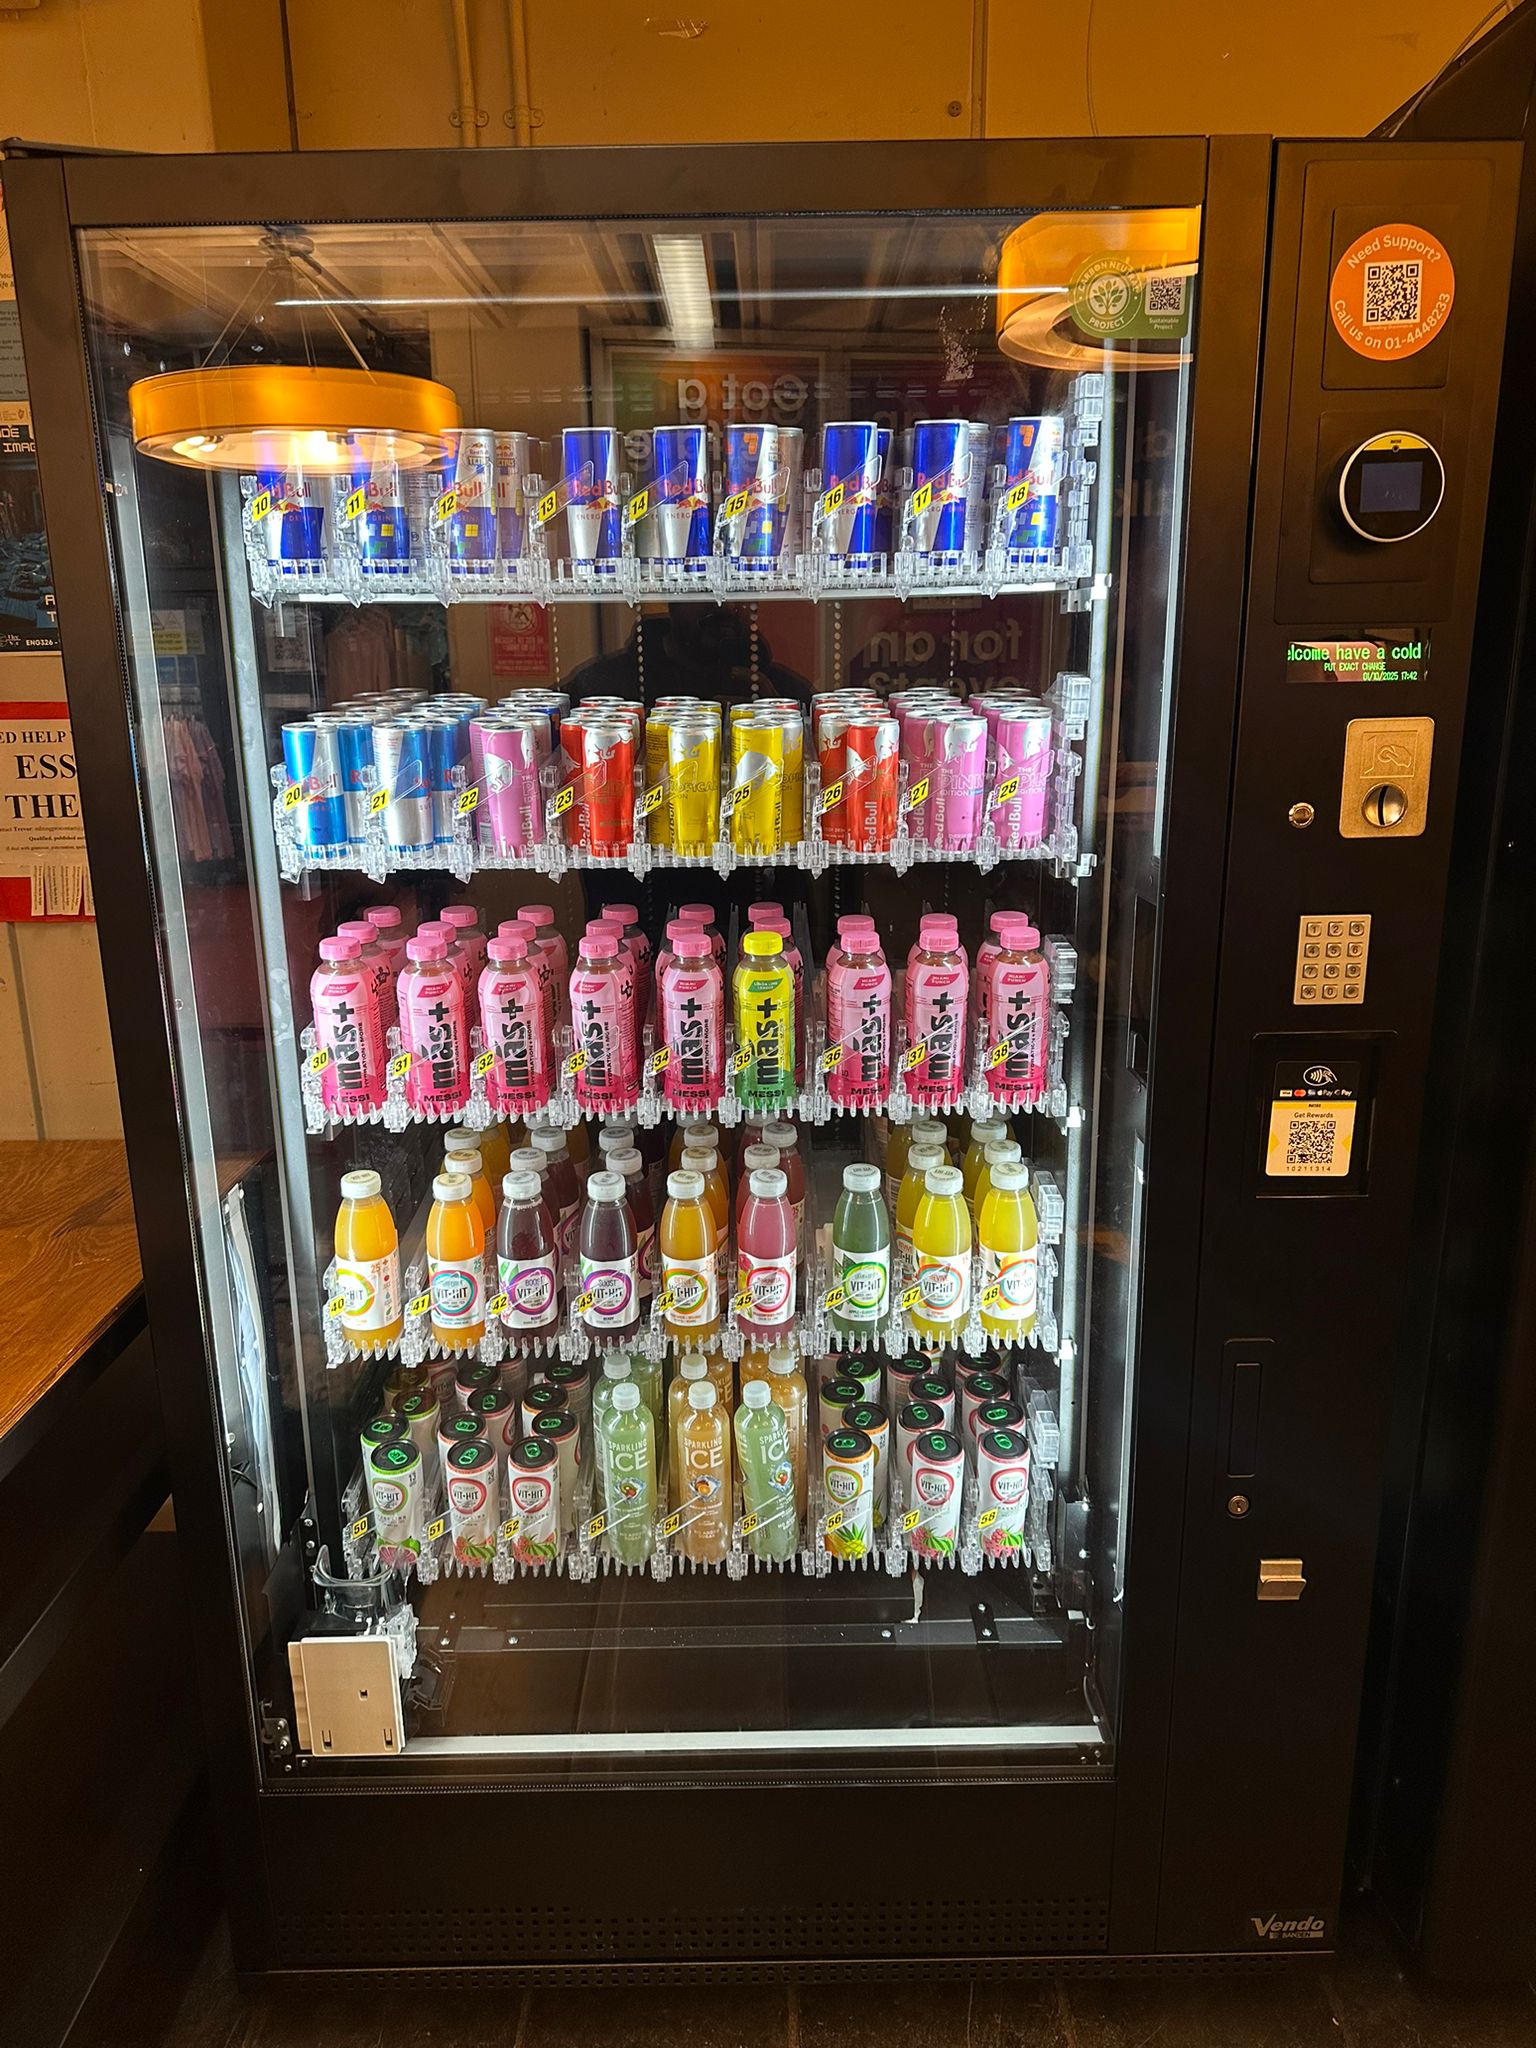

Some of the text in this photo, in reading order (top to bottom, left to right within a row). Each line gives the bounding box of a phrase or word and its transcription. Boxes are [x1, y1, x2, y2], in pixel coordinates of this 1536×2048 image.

[1346, 234, 1442, 270] Need Support?
[1079, 262, 1108, 292] CARBON
[1088, 316, 1125, 330] PROJECT
[1334, 293, 1451, 351] Call us on 01-4448233
[0, 428, 20, 438] DE
[574, 480, 601, 497] Red
[664, 479, 691, 496] Red
[754, 478, 777, 494] Bull
[828, 491, 841, 508] 16
[916, 488, 929, 508] 17
[1011, 486, 1025, 504] 18
[254, 496, 268, 515] 10
[349, 496, 360, 513] 11
[440, 496, 454, 515] 12
[541, 497, 554, 516] 13
[632, 496, 645, 515] 14
[729, 496, 744, 512] 15
[1336, 644, 1370, 660] have
[1377, 647, 1385, 659] a
[1392, 642, 1422, 659] cold
[1324, 662, 1386, 671] PUT EXACT CHANGE
[1362, 672, 1399, 681] 01/10/2025
[22, 731, 66, 743] HELP
[14, 754, 77, 779] ESS
[286, 787, 301, 805] 20
[735, 786, 750, 804] 25
[826, 786, 841, 803] 26
[912, 782, 928, 801] 27
[1000, 780, 1018, 798] 28
[4, 794, 79, 819] THE
[372, 792, 386, 809] 21
[462, 792, 476, 808] 22
[558, 791, 572, 808] 23
[646, 790, 662, 808] 24
[865, 802, 877, 824] Bull
[936, 798, 945, 823] Bull
[1009, 797, 1022, 822] Bull
[520, 806, 533, 830] Bull
[313, 1052, 327, 1069] 30
[654, 1052, 669, 1067] 34
[737, 1052, 750, 1068] 35
[826, 1049, 841, 1065] 36
[910, 1046, 924, 1064] 37
[994, 1045, 1008, 1062] 38
[396, 1058, 408, 1072] 31
[480, 1054, 493, 1070] 32
[570, 1054, 585, 1070] 33
[748, 1089, 785, 1097] MESSI
[918, 1085, 954, 1093] MESSI
[995, 1082, 1034, 1091] MESSI
[423, 1091, 462, 1102] MESSI
[497, 1091, 536, 1100] MESSI
[579, 1092, 613, 1100] MESSI
[580, 1294, 593, 1308] 43
[660, 1293, 673, 1306] 44
[738, 1293, 751, 1307] 45
[828, 1290, 842, 1303] 46
[904, 1290, 918, 1303] 47
[984, 1288, 998, 1301] 48
[331, 1298, 344, 1312] 40
[413, 1299, 425, 1311] 41
[494, 1296, 507, 1310] 42
[684, 1437, 722, 1449] SPARKLING
[760, 1425, 787, 1445] SPARKLI
[608, 1438, 647, 1452] SPARKLING
[761, 1433, 790, 1464] ICE
[610, 1448, 650, 1472] ICE
[685, 1446, 725, 1469] ICE
[666, 1517, 678, 1531] 54
[744, 1517, 757, 1530] 55
[828, 1514, 841, 1528] 56
[905, 1512, 919, 1526] 57
[981, 1511, 996, 1525] 58
[354, 1521, 366, 1534] 50
[430, 1524, 441, 1536] 51
[506, 1521, 519, 1533] 52
[591, 1520, 603, 1533] 53
[1250, 1913, 1325, 1937] Vendo
